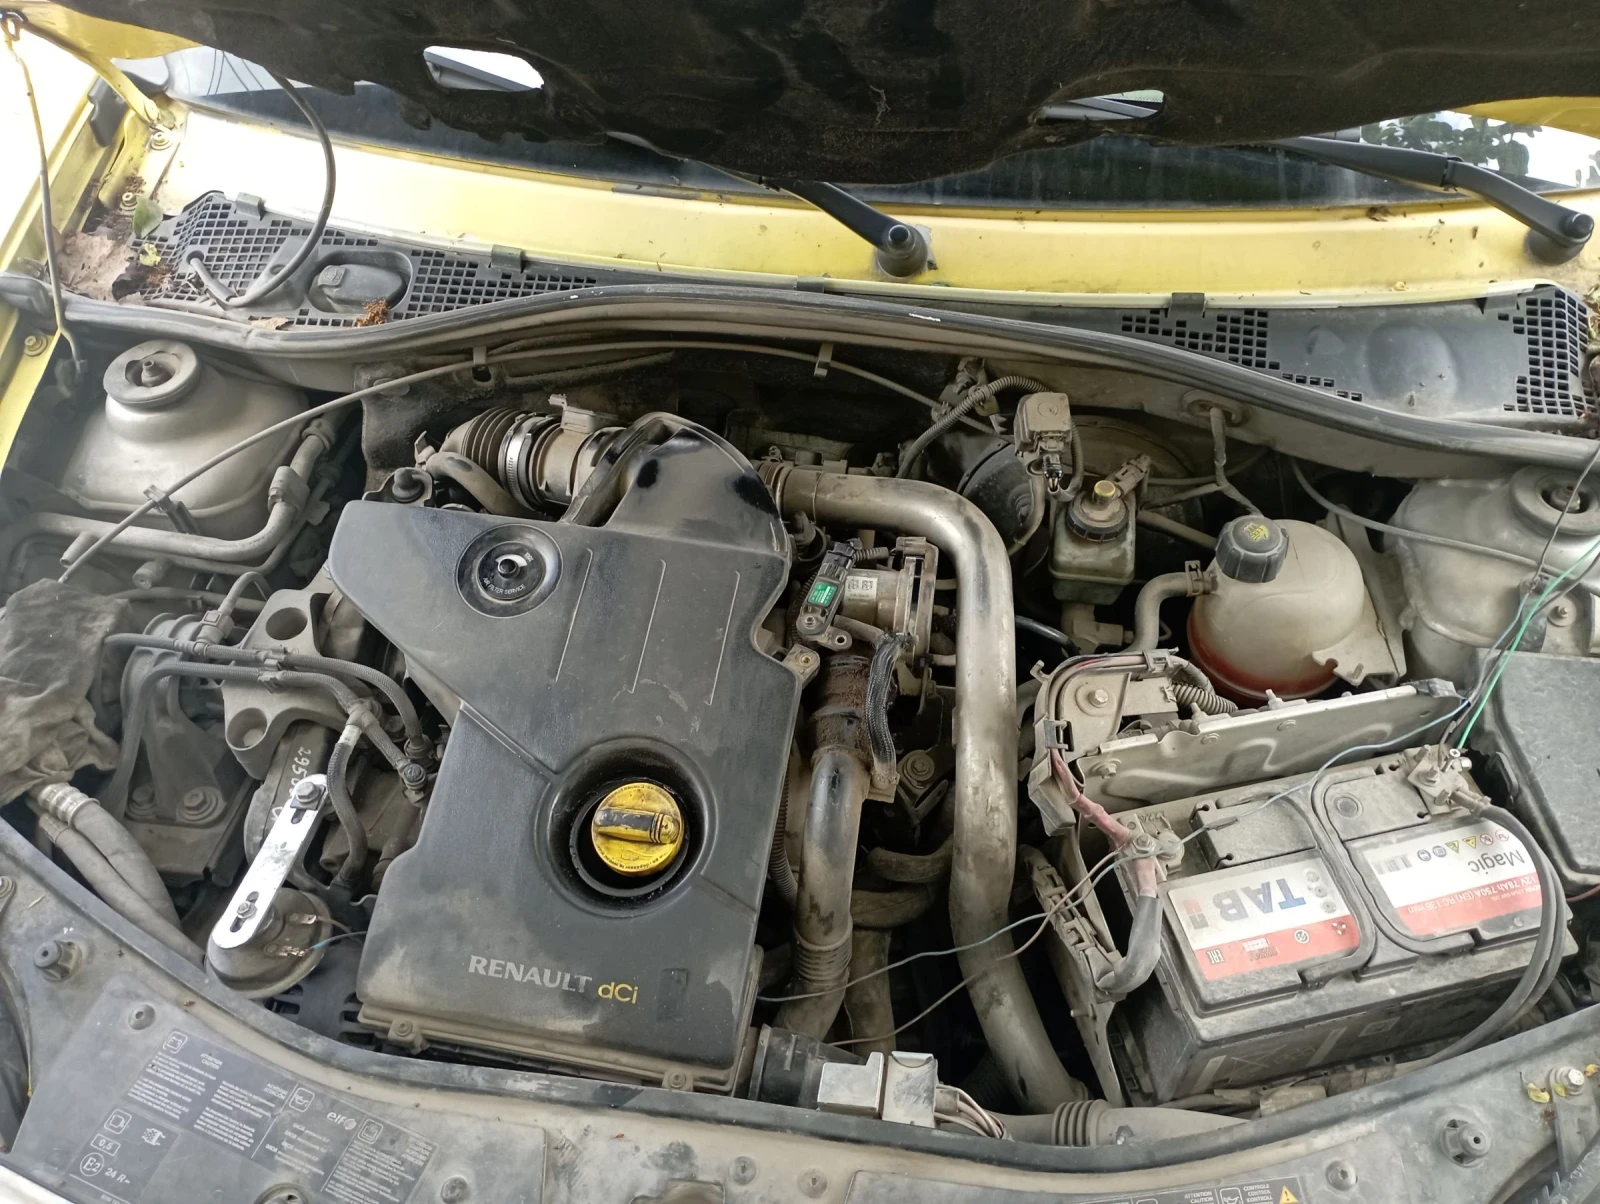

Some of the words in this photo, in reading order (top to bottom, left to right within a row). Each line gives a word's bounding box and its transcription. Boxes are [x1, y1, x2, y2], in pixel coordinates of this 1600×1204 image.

[483, 577, 491, 586] AIR
[487, 582, 503, 594] FILTER
[504, 583, 526, 595] SERVICE
[1468, 850, 1525, 875] Magic
[1499, 879, 1521, 891] 78Ah
[1521, 875, 1538, 886] 12V
[1456, 890, 1474, 903] (EN)
[1475, 885, 1498, 897] 750A
[1213, 878, 1307, 922] TAB
[1424, 898, 1443, 911] 136
[1444, 897, 1456, 906] RC
[1408, 904, 1425, 914] min
[468, 955, 593, 993] RENAULT
[597, 982, 639, 1004] dCi
[327, 1111, 346, 1126] elf
[98, 1139, 114, 1151] 0,5
[83, 1157, 101, 1172] E2
[105, 1168, 118, 1178] 24
[1184, 1190, 1213, 1199] ATTENTION
